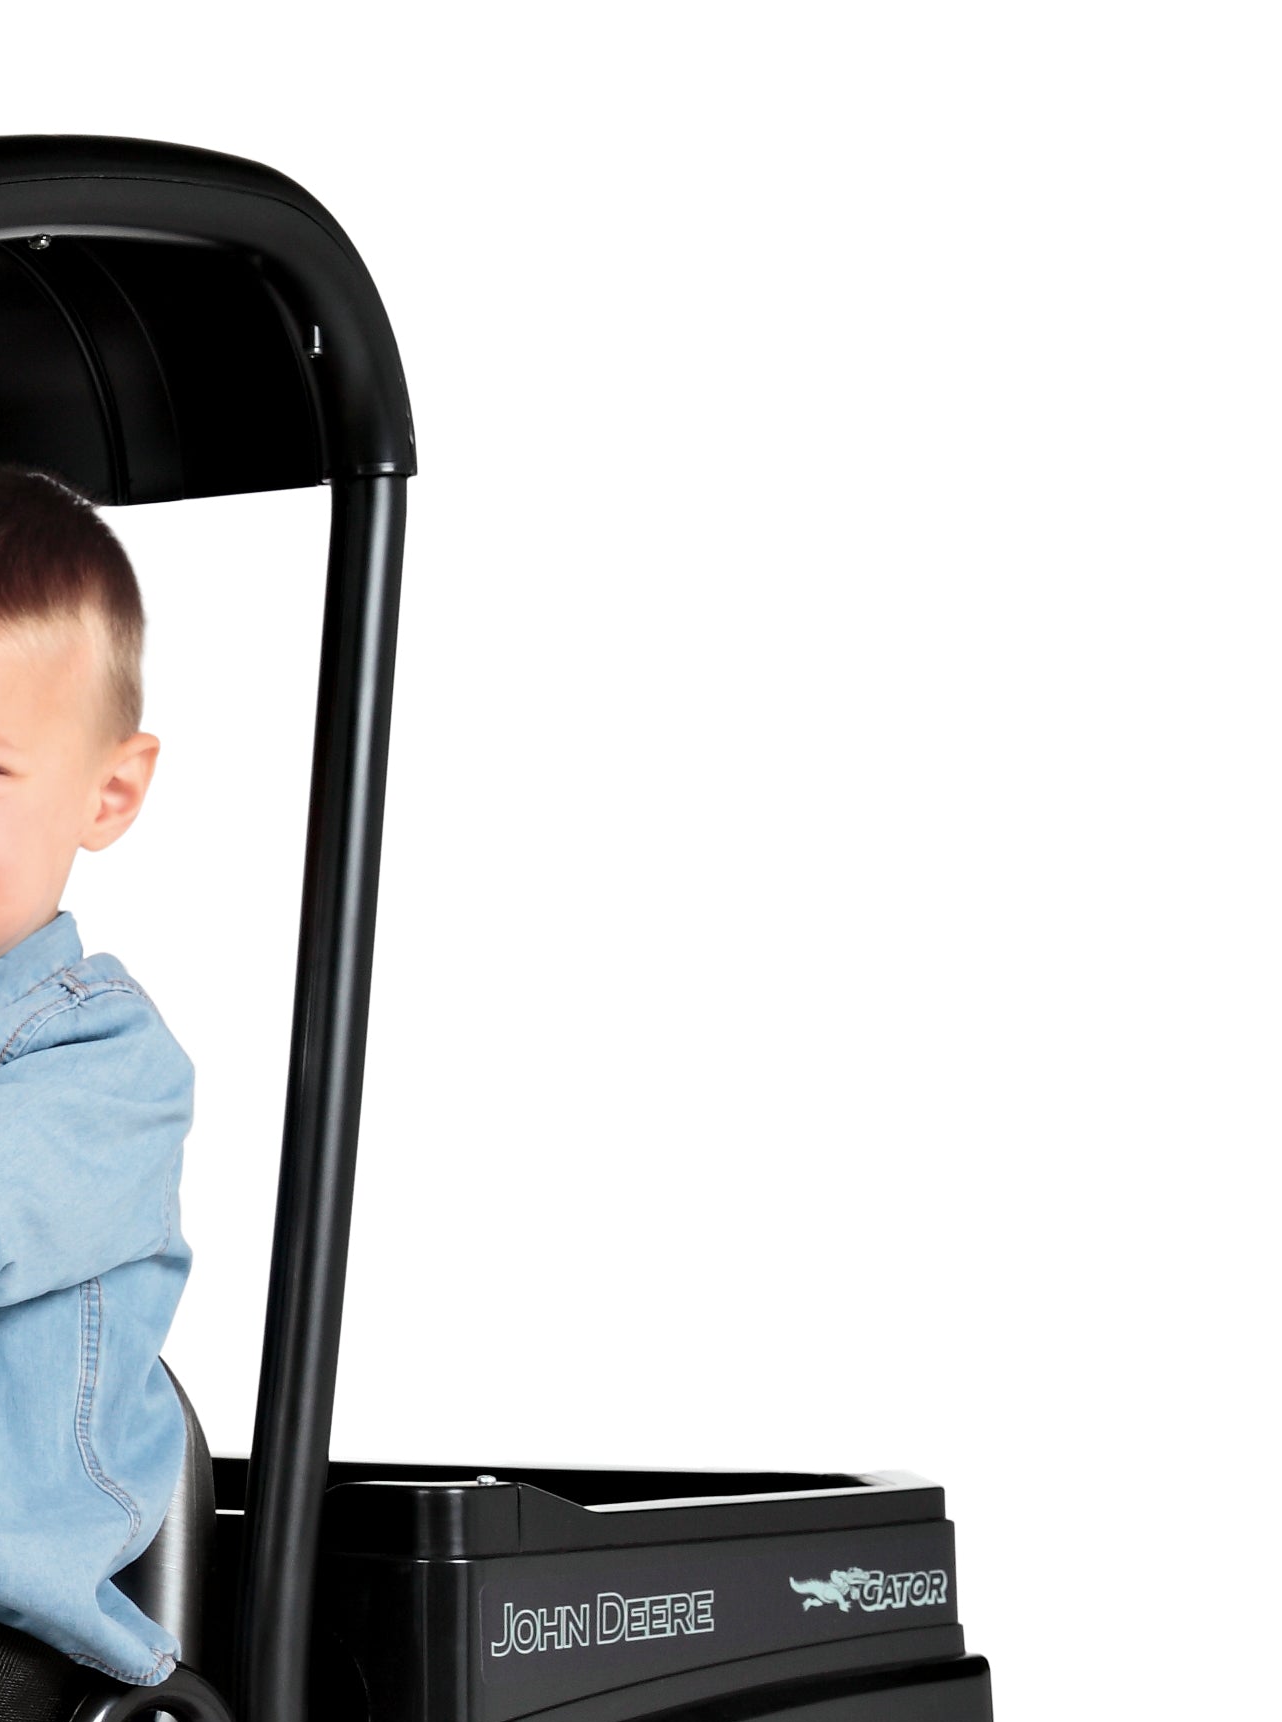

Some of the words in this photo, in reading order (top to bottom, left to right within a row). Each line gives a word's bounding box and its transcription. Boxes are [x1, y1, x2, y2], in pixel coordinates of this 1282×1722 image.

[859, 1568, 949, 1612] GATOR
[490, 1602, 590, 1657] JOHN
[596, 1589, 715, 1645] DEERE
